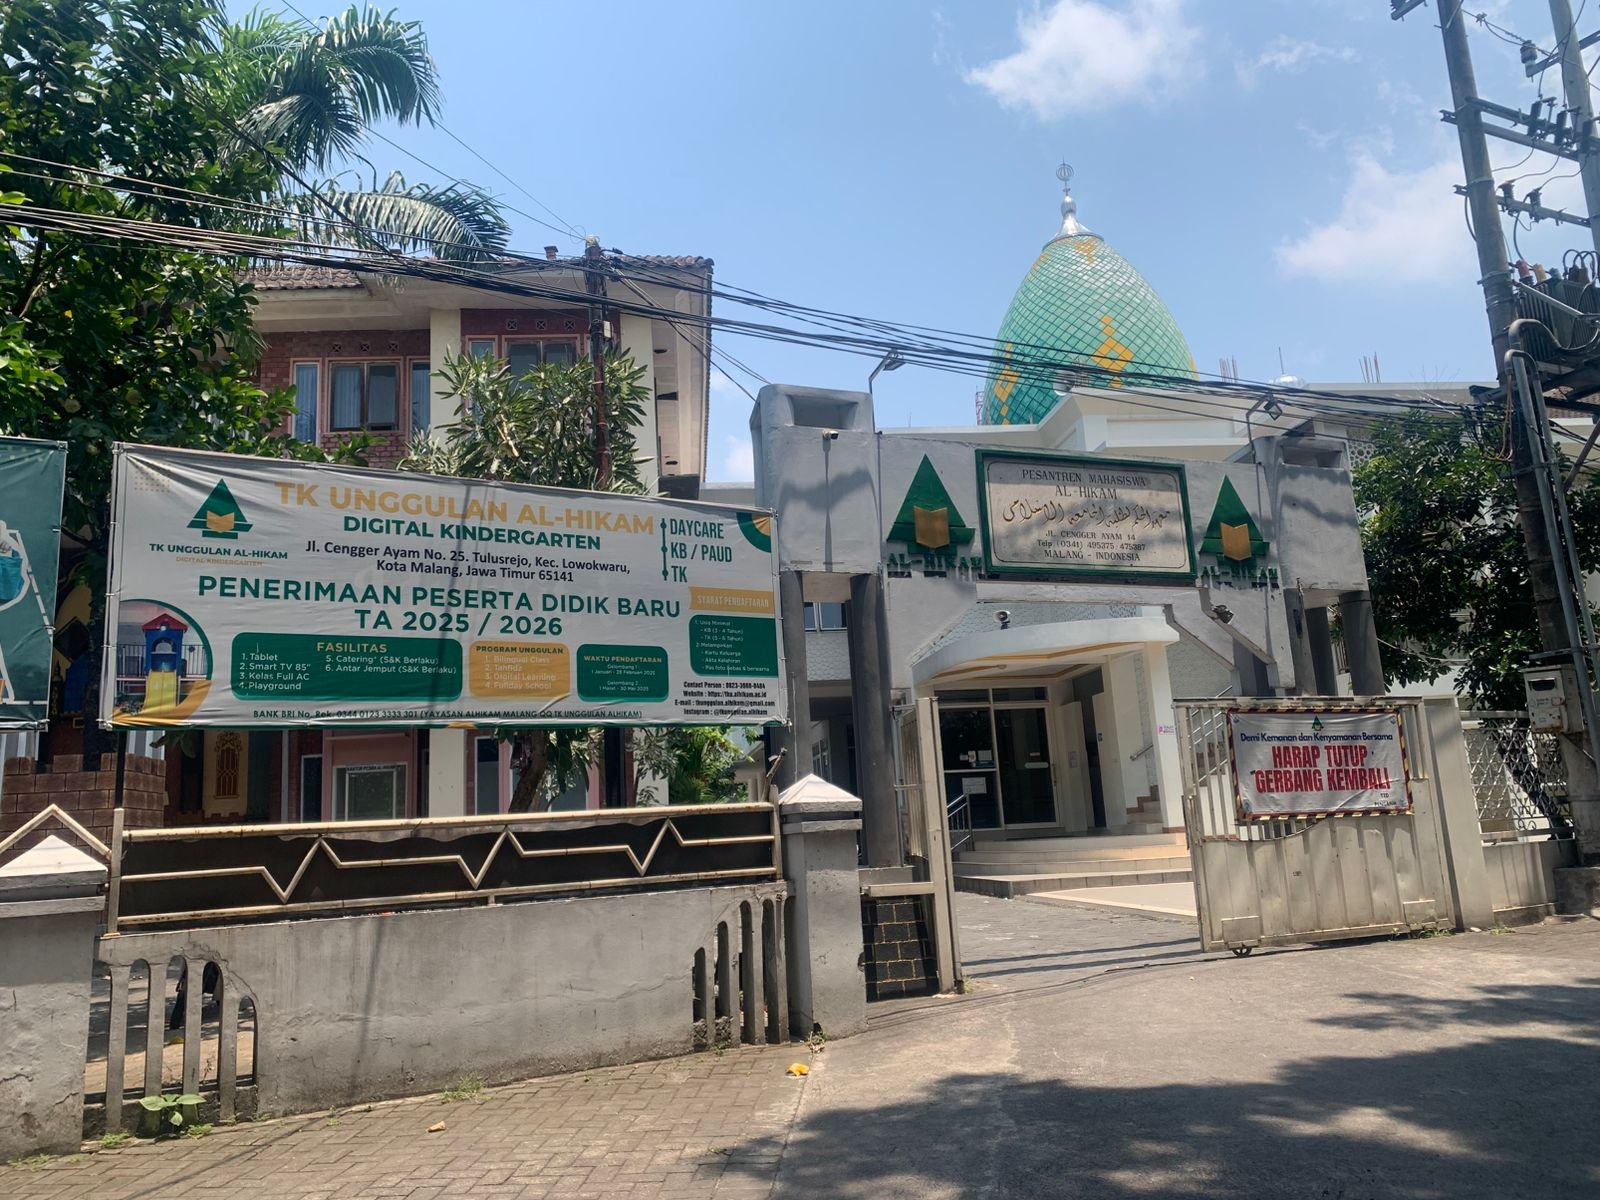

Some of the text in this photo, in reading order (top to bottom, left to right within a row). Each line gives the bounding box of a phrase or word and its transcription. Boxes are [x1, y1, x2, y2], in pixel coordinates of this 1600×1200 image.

[1022, 469, 1146, 487] PESANTREN MAHASISWA
[274, 481, 655, 535] TK UNGGULAN AL-HIKAM
[343, 516, 601, 551] DIGITAL KINDERGARTEN
[670, 518, 725, 540] DAYCARE
[1061, 530, 1097, 539] CENGGER
[1101, 533, 1122, 541] AYAM
[149, 543, 288, 560] TK UNGGULAN AL-HIKAM
[1056, 540, 1084, 549] (0341)
[1086, 541, 1115, 550] 495375
[305, 540, 320, 552] Jl.
[324, 541, 380, 558] Cengger
[383, 546, 420, 560] Ayam
[424, 549, 447, 561] No.
[472, 552, 532, 568] Tulusrejo,
[535, 556, 559, 569] Kec.
[562, 558, 631, 575] Lowokwaru,
[670, 545, 733, 563] KB / PAUD
[1044, 549, 1141, 562] MALANG INDONESIA
[376, 559, 574, 583] Kota Malang, Jawa Timur 65141
[671, 565, 688, 583] TK
[199, 575, 680, 618] PENERIMAAN PESERTA DIDIK BARU
[354, 610, 563, 637] TA 2025 / 2026
[316, 642, 387, 654] FASILITAS
[476, 646, 564, 655] PROGRAM UNGGULAN
[250, 653, 278, 661] Tablet
[326, 655, 334, 663] 5.
[380, 656, 401, 665] (S&K
[403, 656, 440, 665] Berlaku)
[584, 655, 662, 664] WAKTU PENDAFTARAN
[240, 662, 247, 670] 2.
[249, 662, 277, 671] Smart
[279, 663, 293, 671] TV
[325, 664, 456, 675] 6. Antar Jemput (S&K Berlaku)
[240, 671, 310, 680] 3. Kelas Full AC
[249, 681, 301, 691] Playground
[253, 710, 279, 718] BANK
[281, 710, 295, 718] BRI
[1241, 732, 1393, 742] Demi Kemanan dan Kenyamanan Bersama
[1272, 745, 1368, 768] HARAP TUTUP
[1255, 767, 1390, 793] GERBANG KEMBALI
